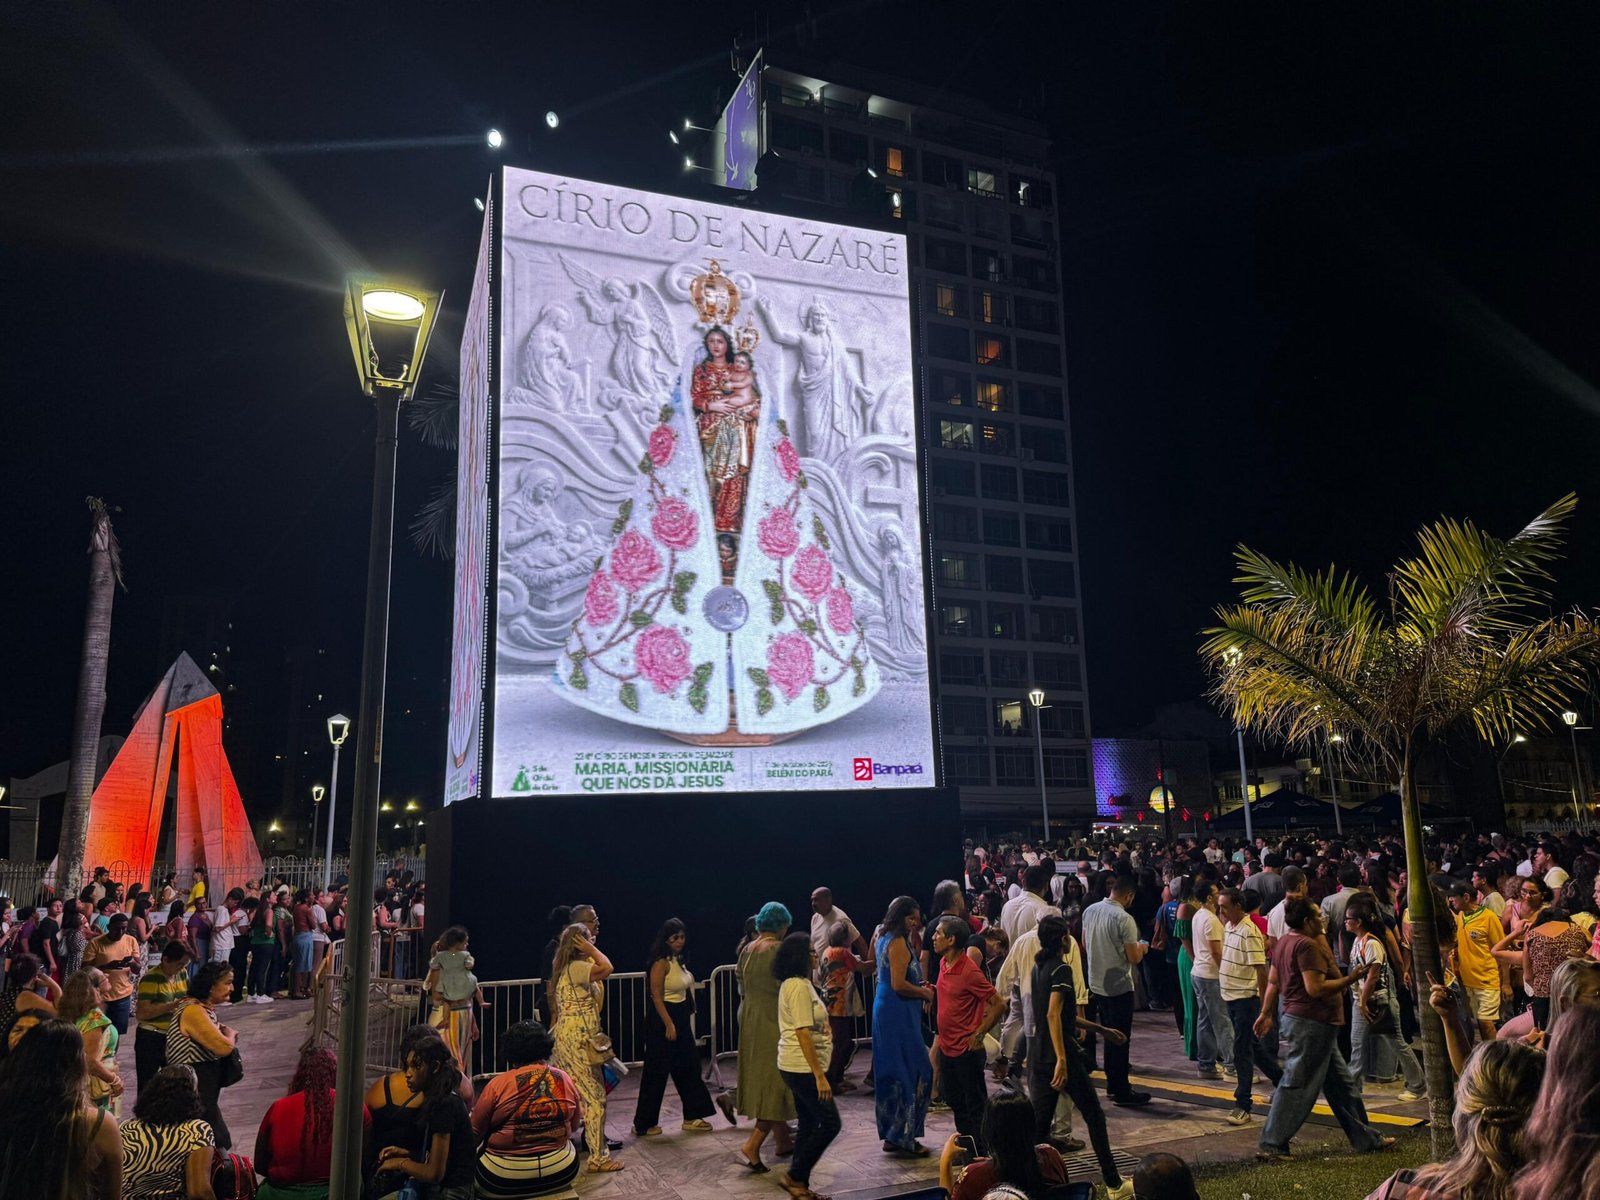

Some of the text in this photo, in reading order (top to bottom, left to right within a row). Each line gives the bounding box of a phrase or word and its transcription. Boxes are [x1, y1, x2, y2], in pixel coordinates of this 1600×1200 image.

[518, 182, 900, 276] CÍRIO DE NAZARÉ
[575, 762, 632, 776] MARIA,
[795, 769, 809, 778] DO
[581, 777, 615, 792] QUE
[617, 777, 651, 790] NOS
[678, 775, 725, 789] JESUS
